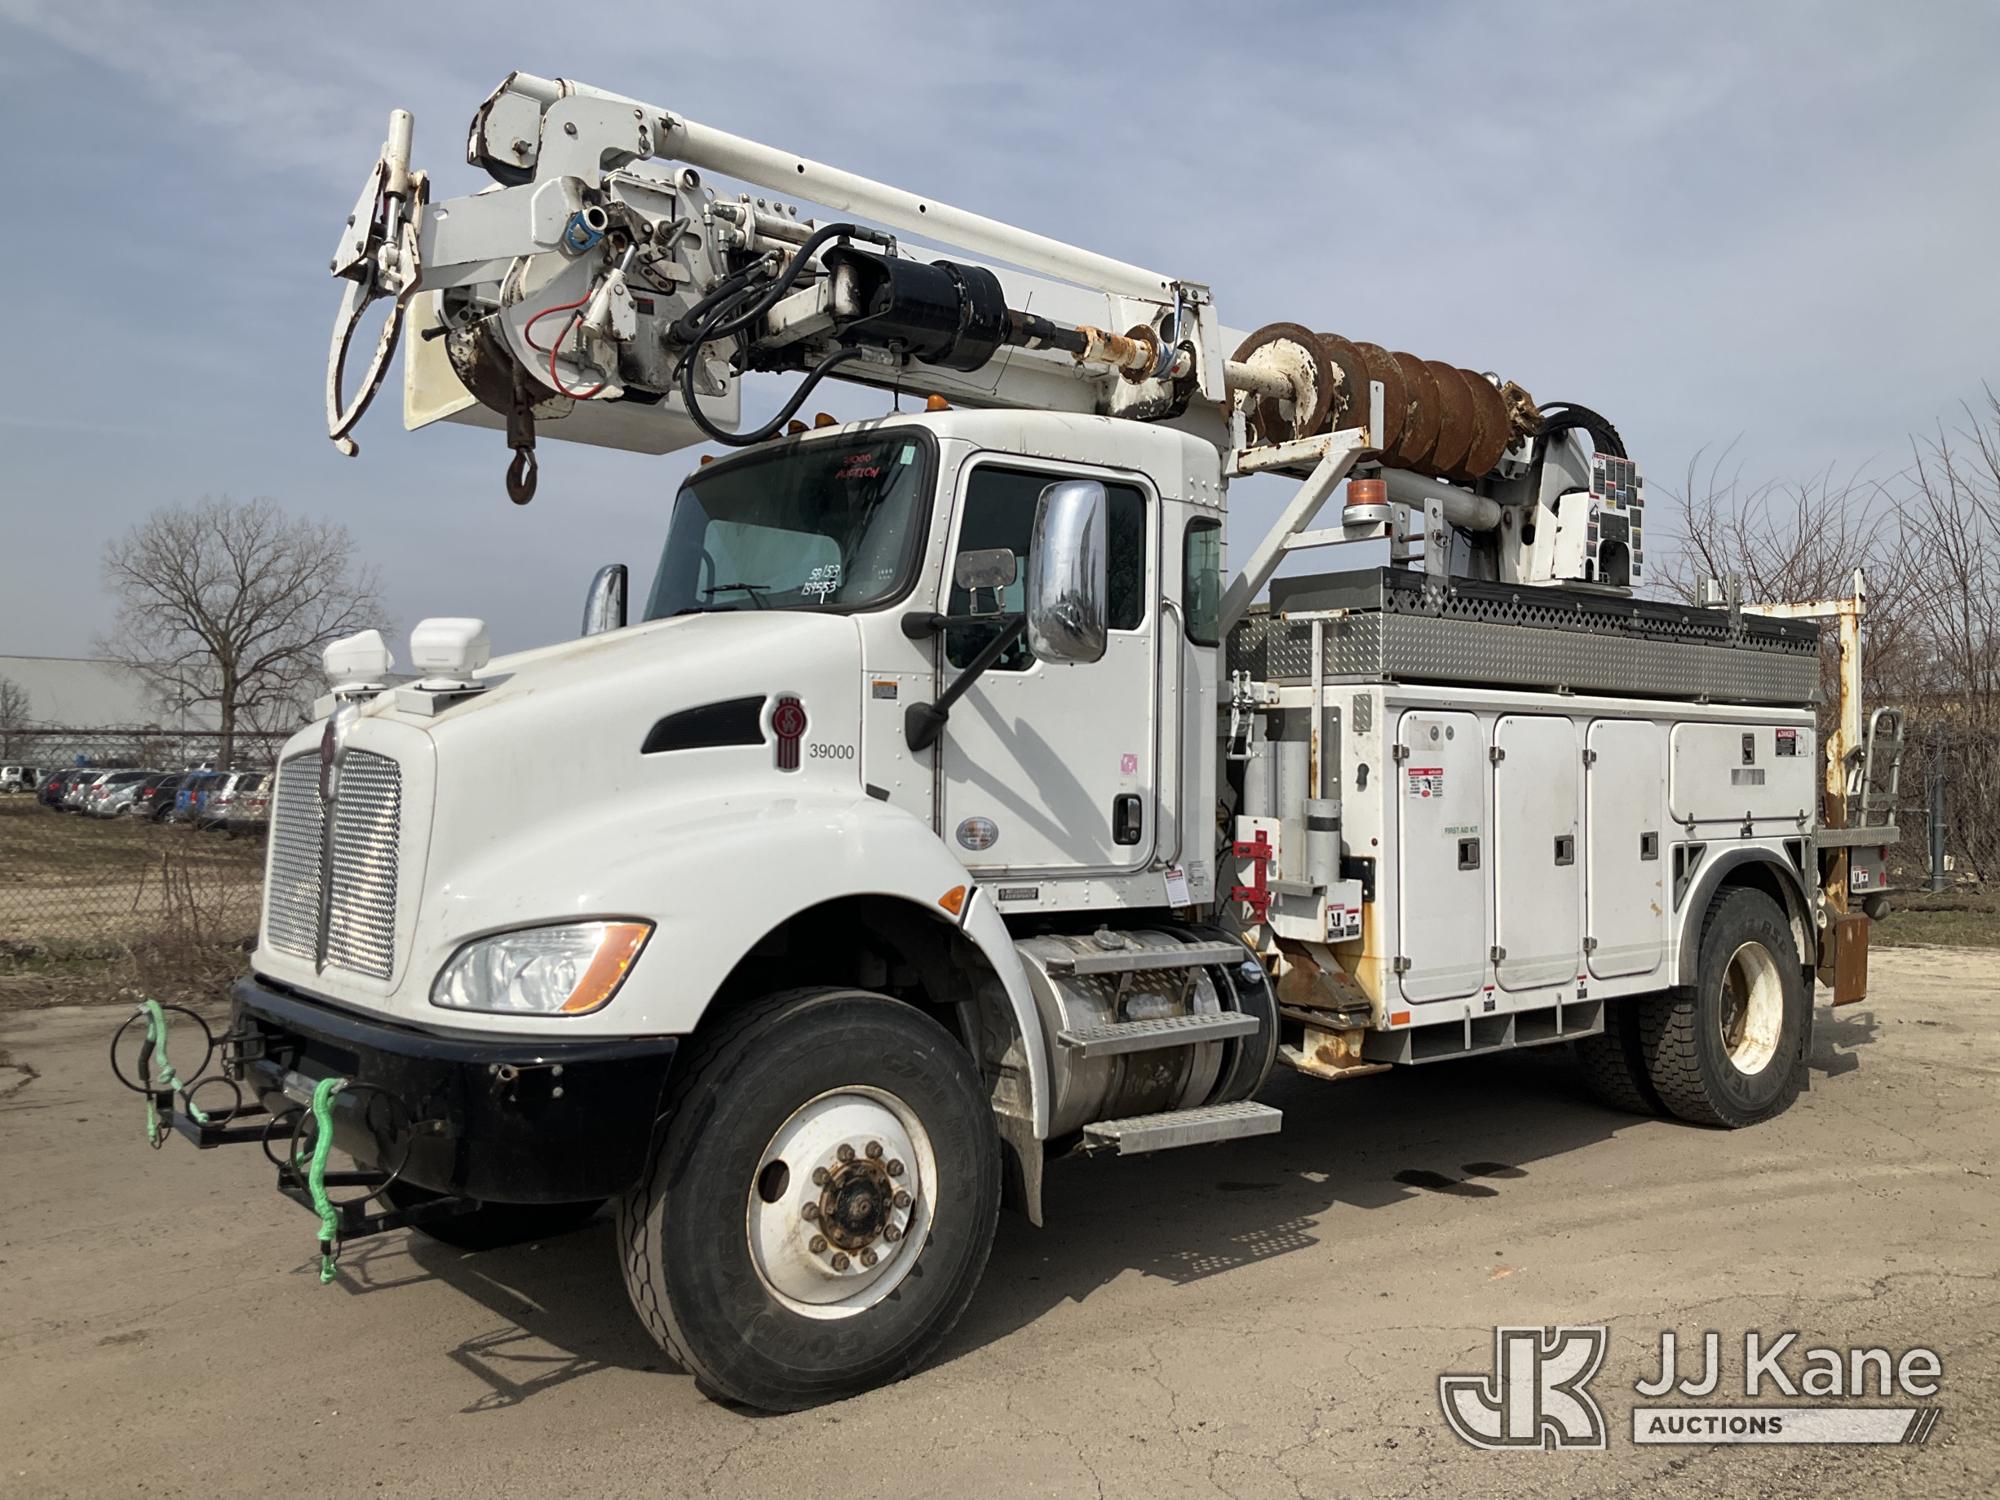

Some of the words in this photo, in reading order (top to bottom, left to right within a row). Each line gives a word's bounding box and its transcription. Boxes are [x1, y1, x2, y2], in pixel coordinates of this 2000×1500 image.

[809, 743, 855, 760] 39000
[1444, 826, 1460, 835] FIRST
[1461, 826, 1469, 834] AID
[1470, 825, 1478, 833] KIT
